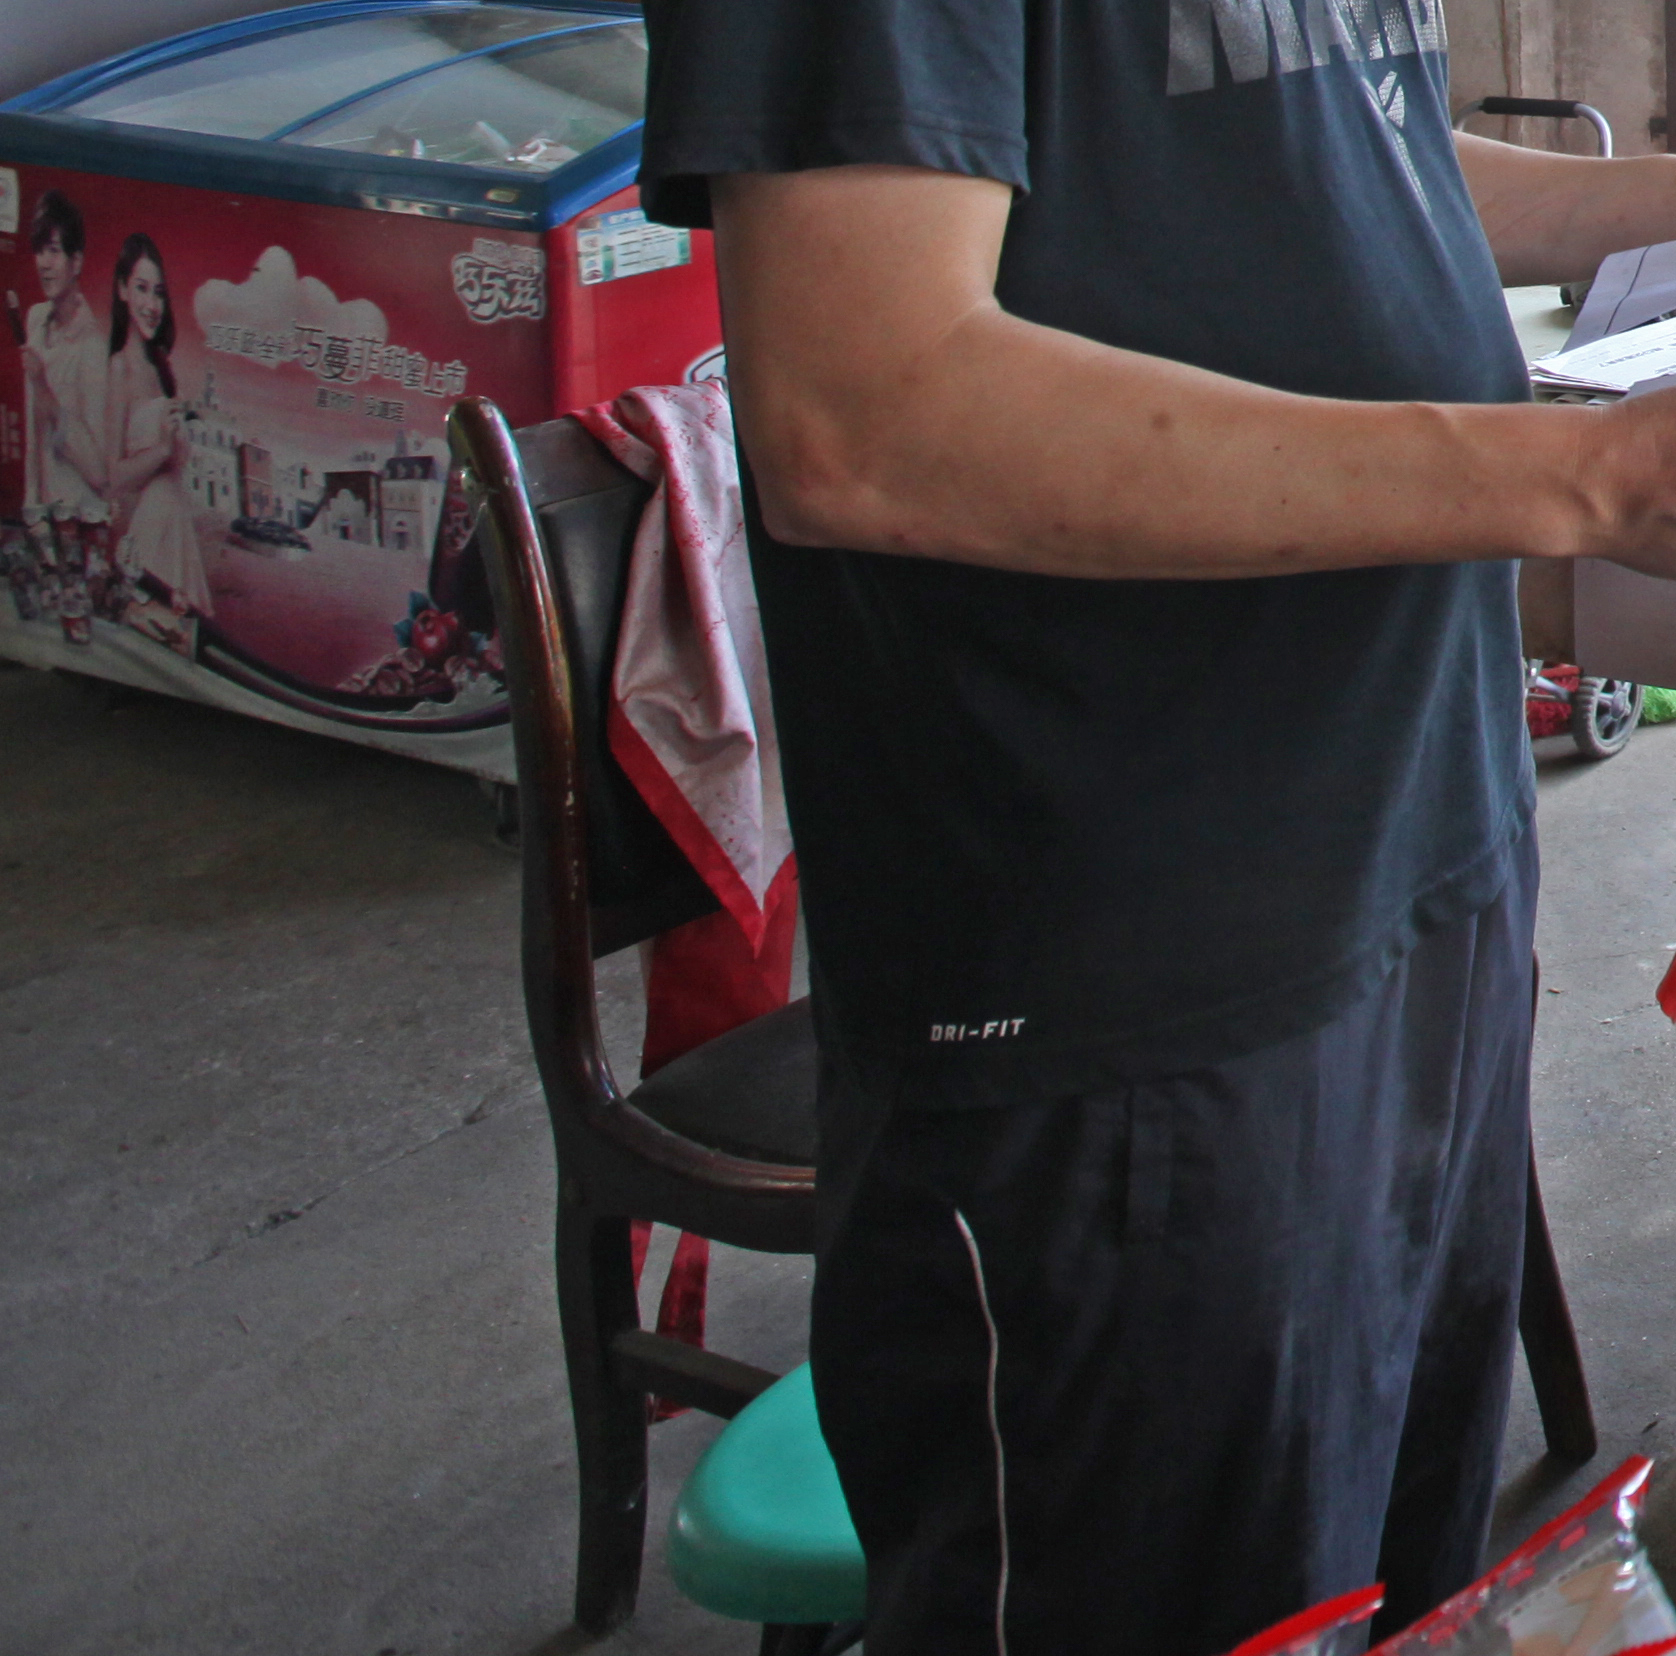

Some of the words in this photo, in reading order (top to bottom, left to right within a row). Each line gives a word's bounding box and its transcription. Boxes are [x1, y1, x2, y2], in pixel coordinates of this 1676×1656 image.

[453, 254, 543, 320] 巧乐兹
[930, 1016, 1026, 1042] DRI-FIT
